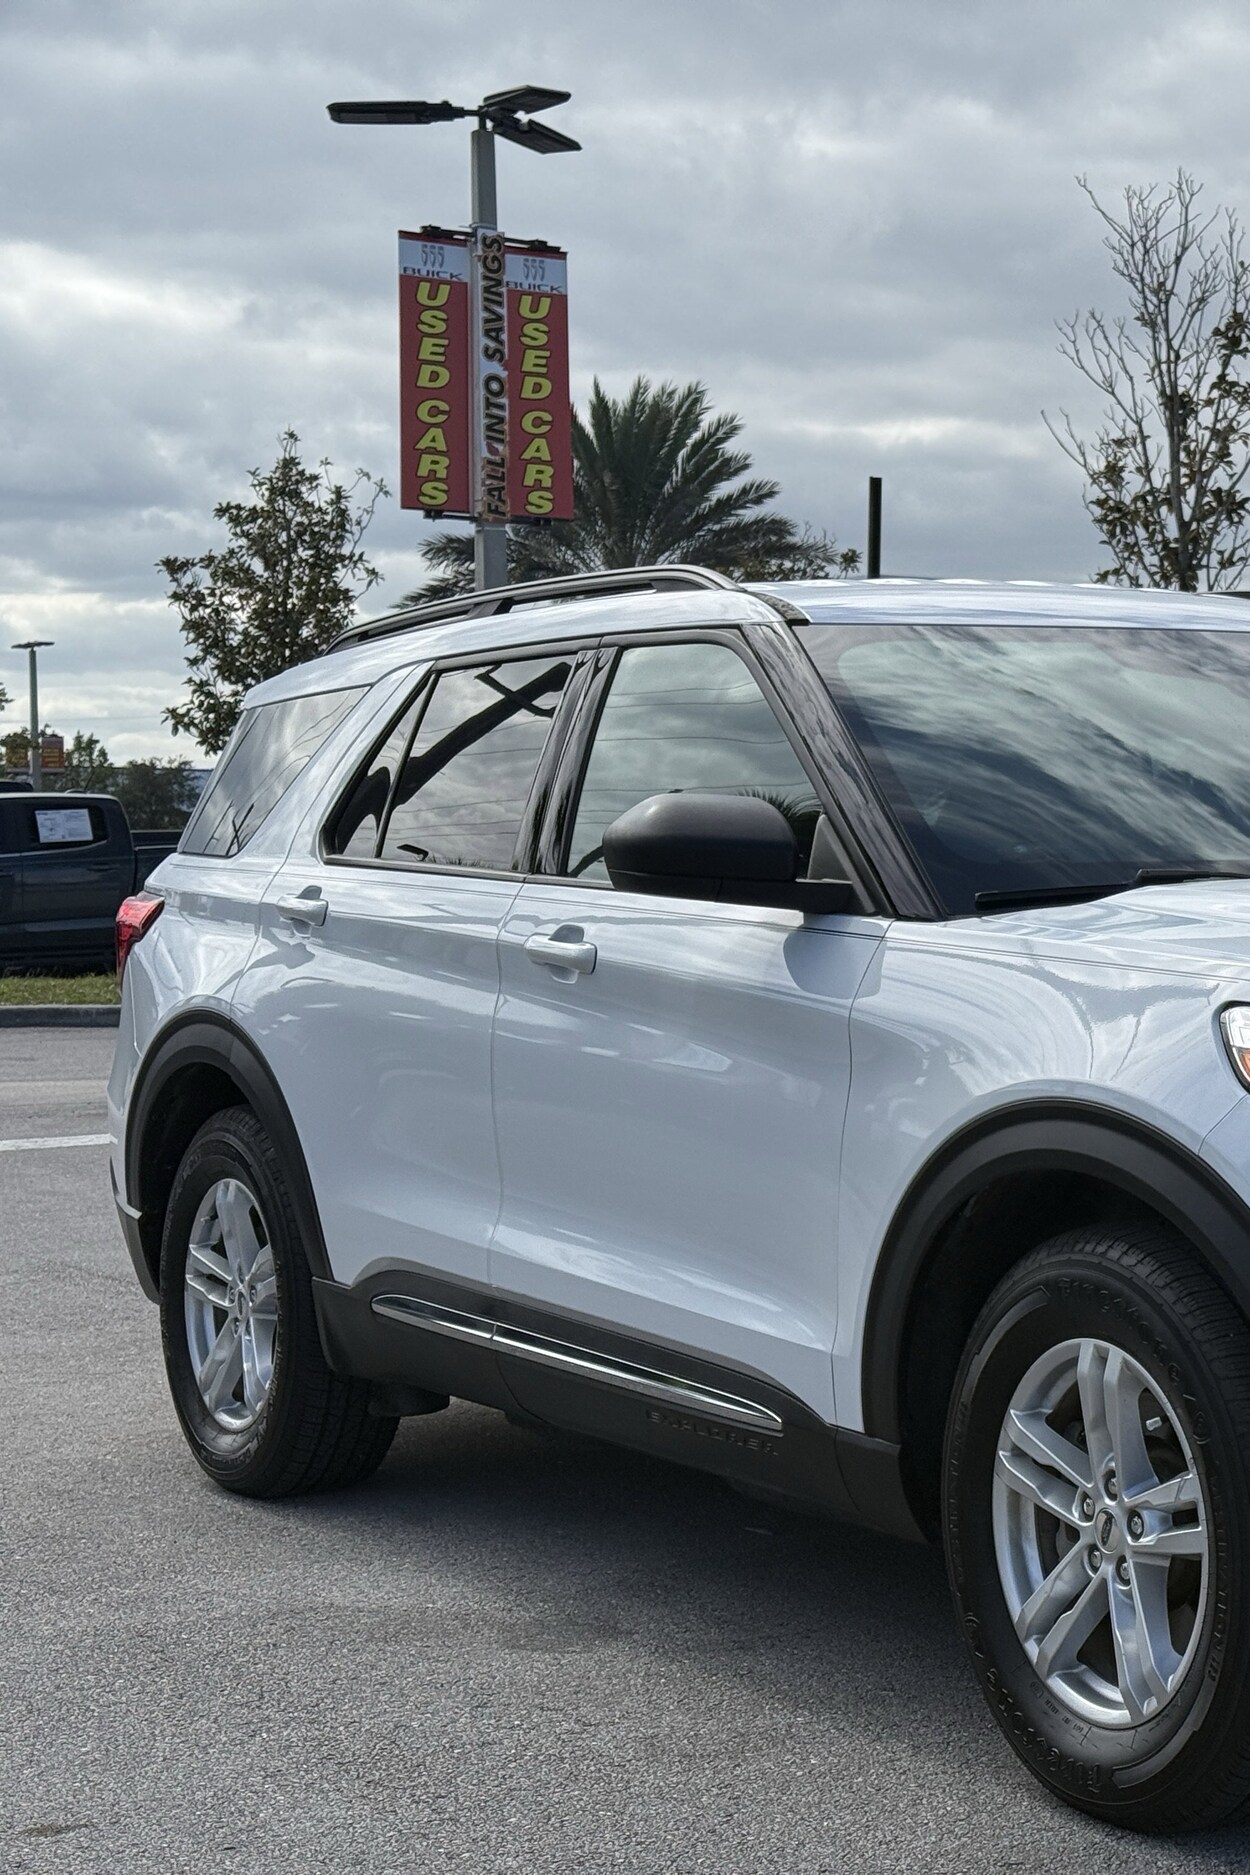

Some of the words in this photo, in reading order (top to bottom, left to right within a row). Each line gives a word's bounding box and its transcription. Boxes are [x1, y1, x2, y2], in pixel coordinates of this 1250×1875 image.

[403, 266, 463, 281] BUICK
[481, 231, 507, 366] SAVINGS
[505, 280, 564, 294] BUICK
[415, 281, 452, 389] USED
[517, 294, 553, 401] USED
[414, 397, 451, 507] CARS
[484, 373, 507, 446] INTO
[486, 456, 507, 518] FALL
[519, 410, 555, 516] CARS
